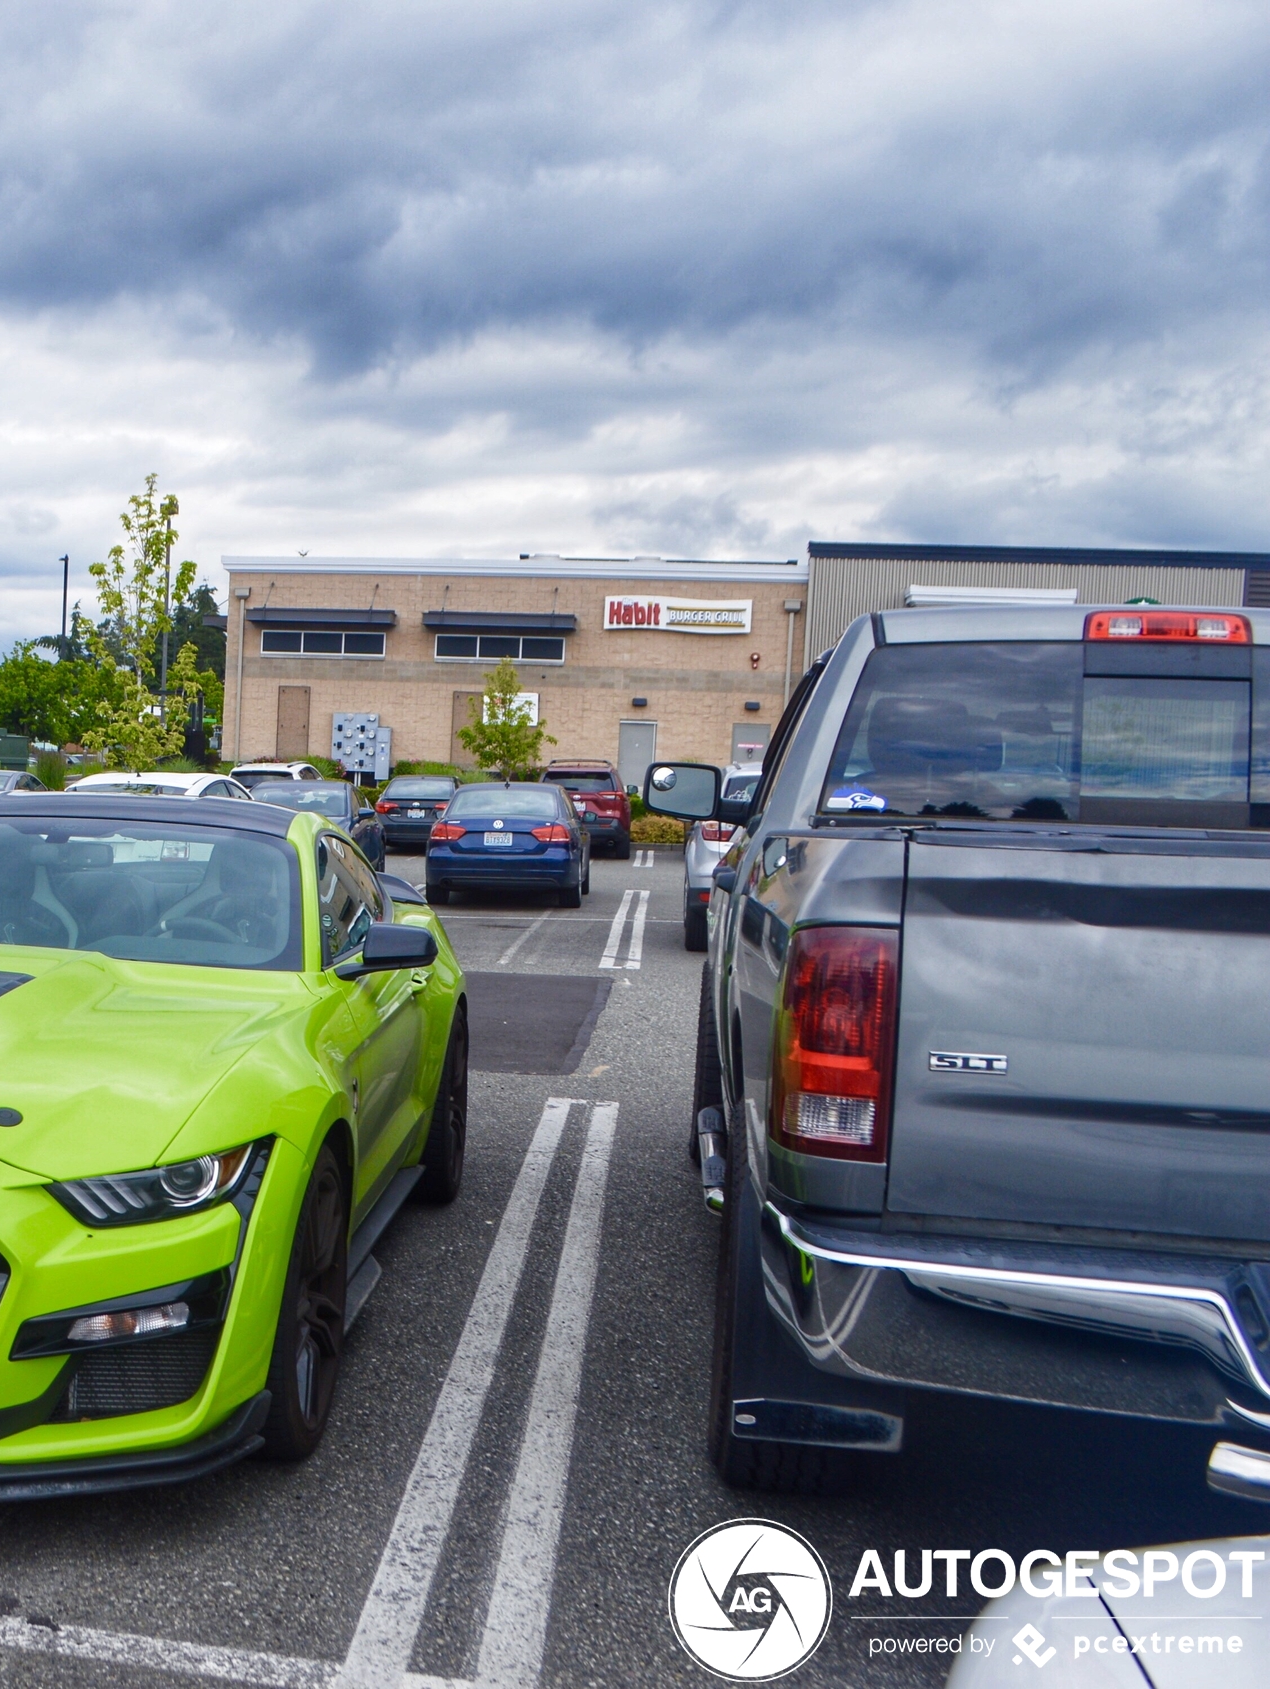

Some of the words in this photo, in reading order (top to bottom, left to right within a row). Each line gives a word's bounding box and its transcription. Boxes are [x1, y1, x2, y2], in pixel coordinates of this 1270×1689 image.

[609, 601, 661, 625] Habit
[670, 610, 712, 622] BURGER
[714, 612, 743, 623] GRILL
[933, 1054, 1004, 1072] SLT
